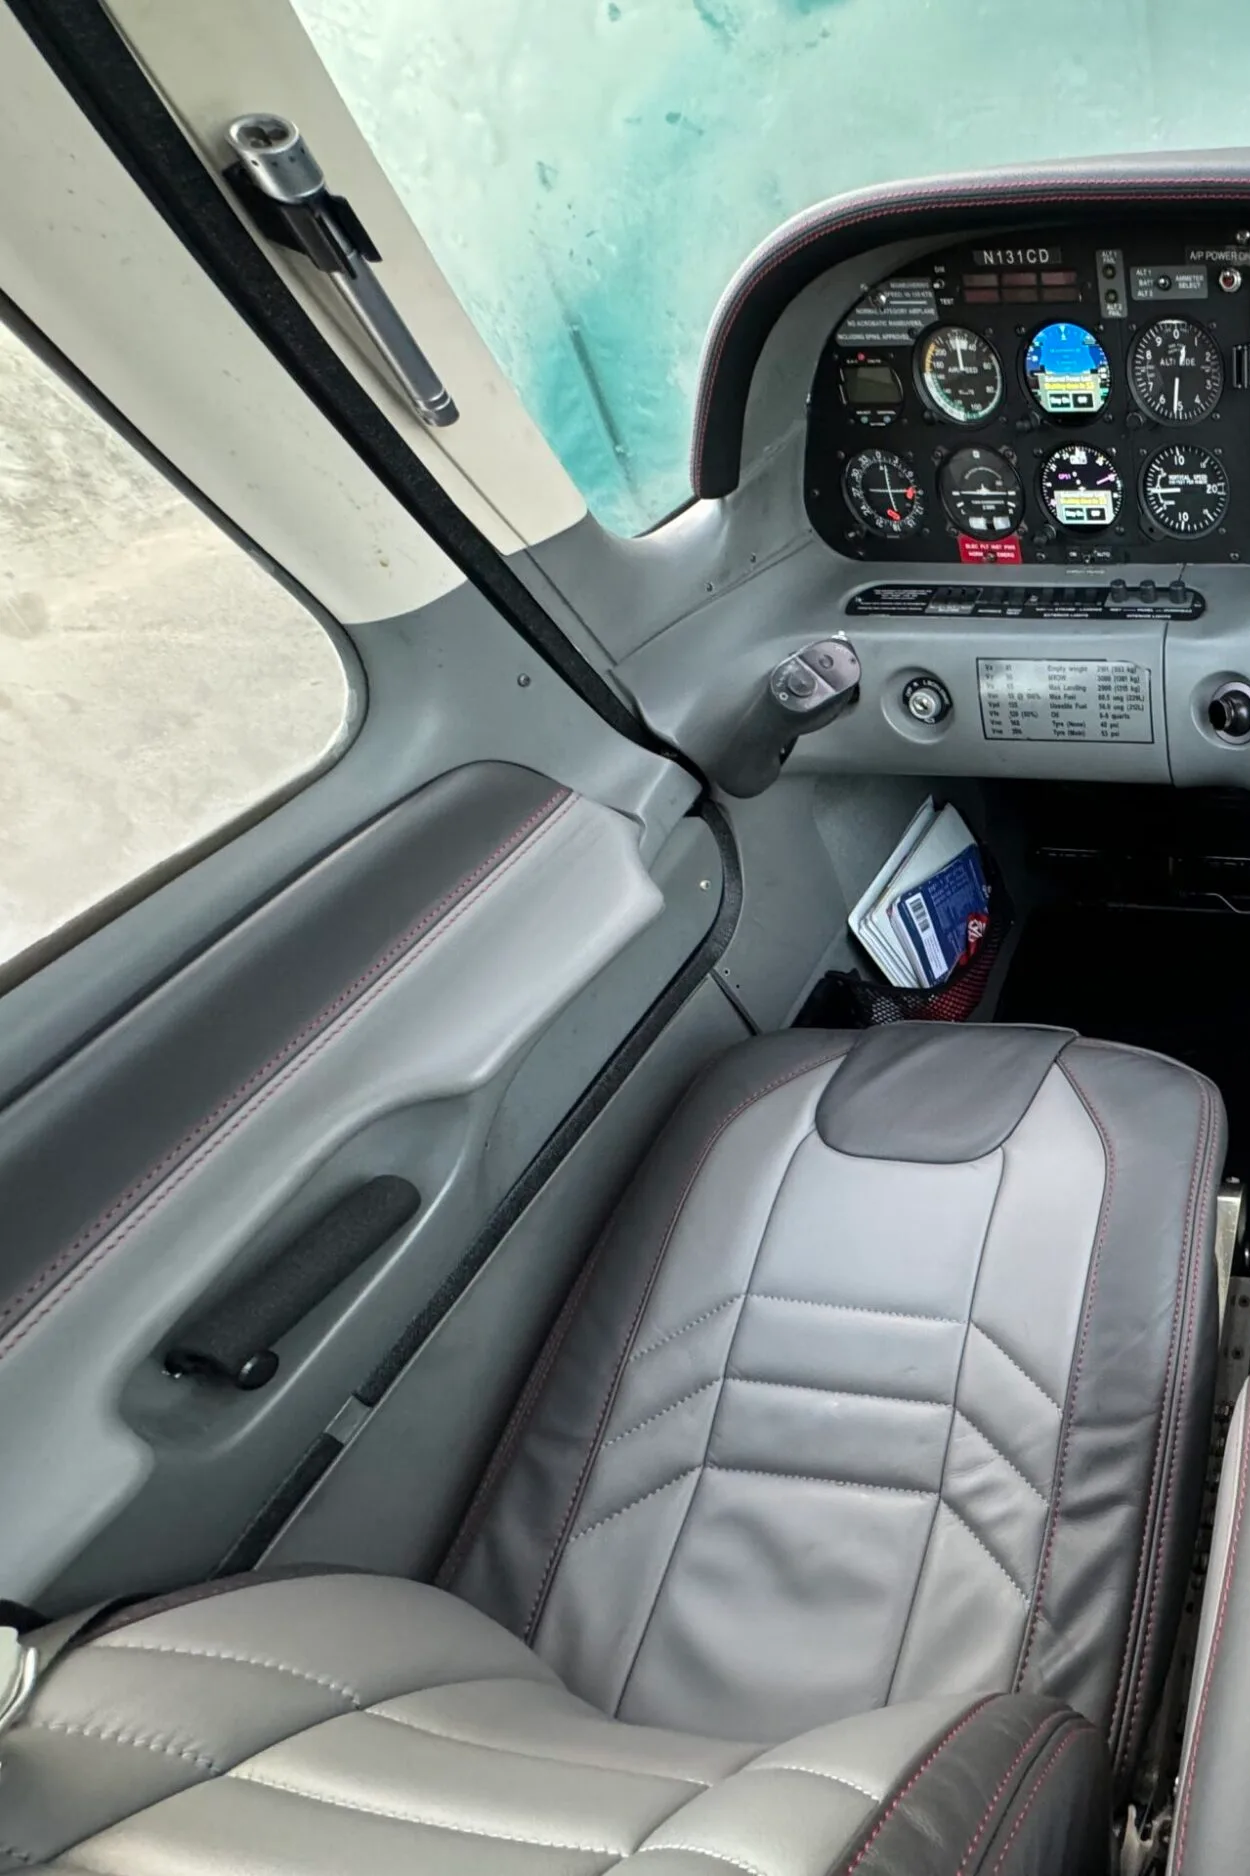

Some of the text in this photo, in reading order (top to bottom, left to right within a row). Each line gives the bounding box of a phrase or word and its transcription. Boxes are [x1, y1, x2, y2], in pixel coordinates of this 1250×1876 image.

[983, 248, 1049, 264] N131CD
[1190, 252, 1204, 260] A/P
[1205, 251, 1237, 260] POWER
[1172, 328, 1180, 339] 0
[1155, 336, 1162, 347] 9
[1145, 350, 1152, 360] 8
[1205, 351, 1211, 362] 2
[1148, 381, 1153, 392] 7
[1205, 379, 1212, 390] 3
[1159, 393, 1166, 405] 6
[1194, 393, 1201, 404] 4
[1177, 400, 1184, 411] 5
[1174, 455, 1185, 466] 10
[1206, 484, 1218, 494] 20
[1178, 511, 1189, 522] 10
